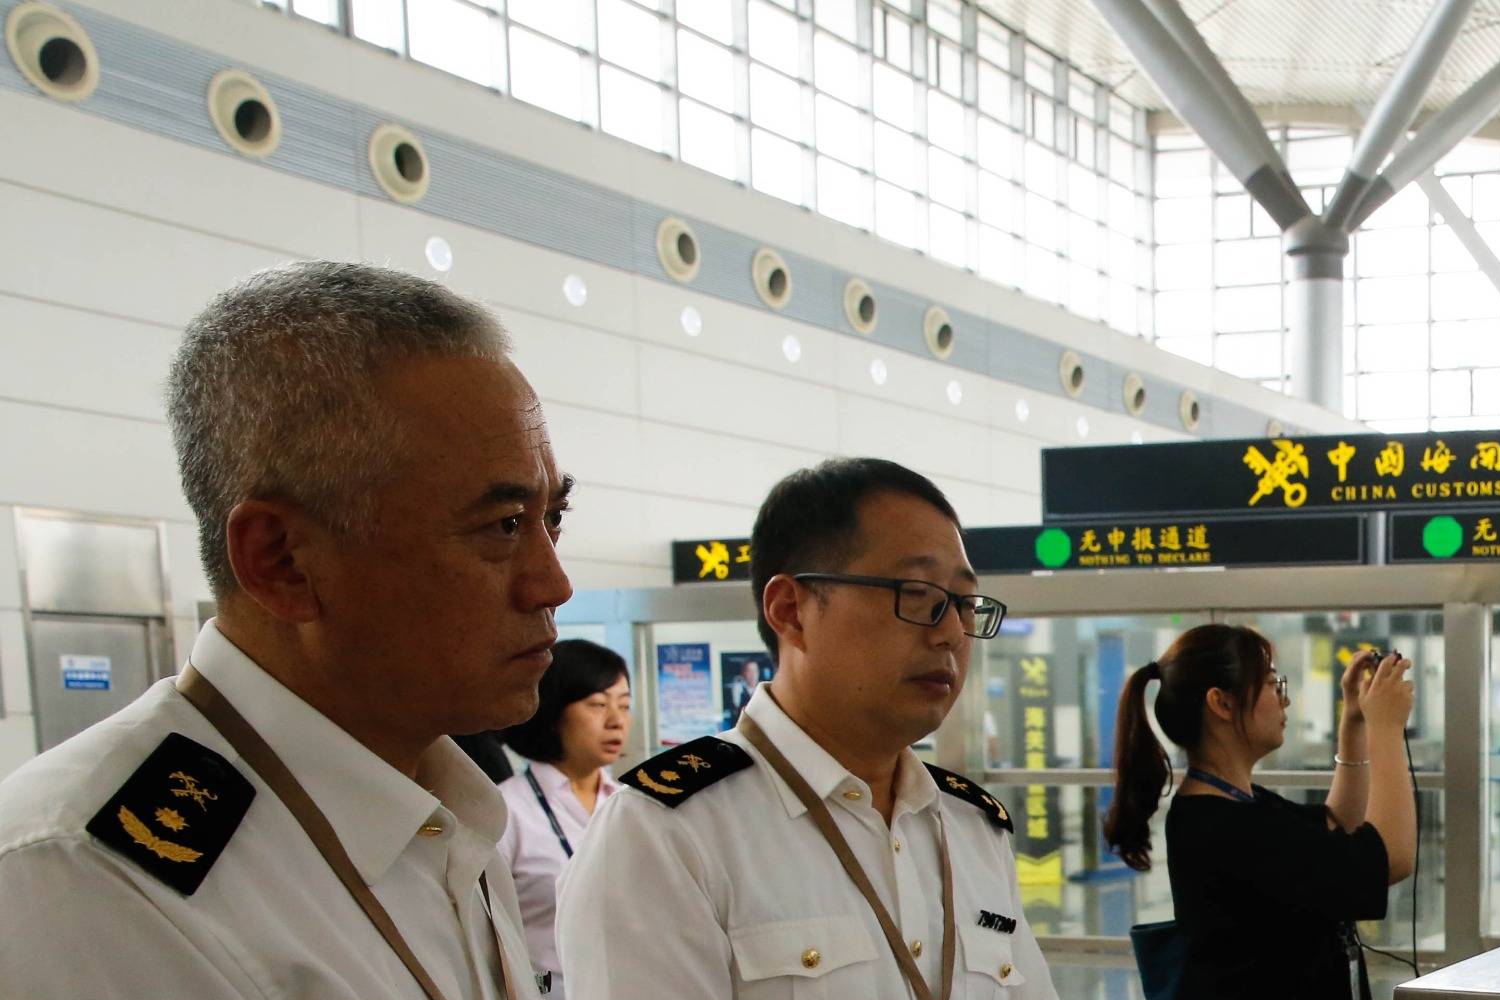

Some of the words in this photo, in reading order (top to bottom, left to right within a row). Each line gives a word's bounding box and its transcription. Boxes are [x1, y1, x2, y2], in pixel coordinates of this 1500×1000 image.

[1331, 485, 1397, 501] CHINA
[1079, 524, 1210, 552] 无申报通道
[1079, 553, 1130, 566] NOTHING
[1136, 553, 1153, 565] TO
[1158, 551, 1211, 564] DECLARE
